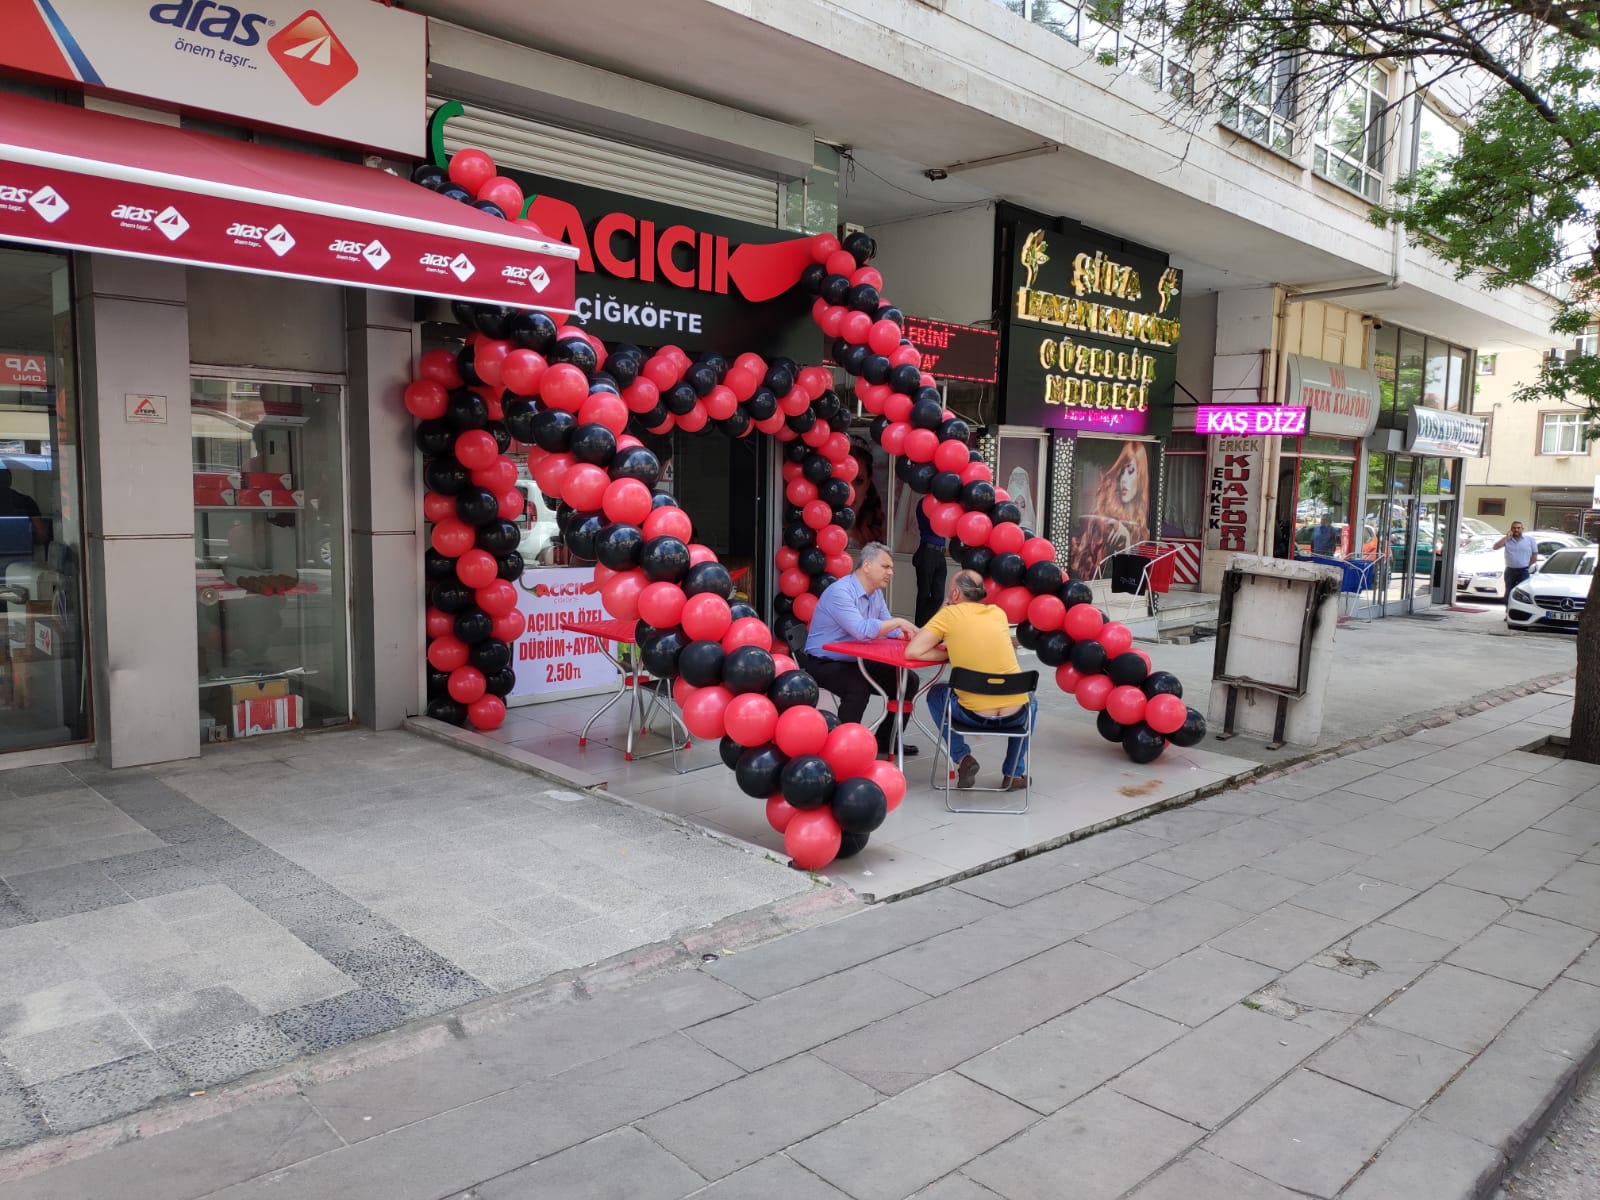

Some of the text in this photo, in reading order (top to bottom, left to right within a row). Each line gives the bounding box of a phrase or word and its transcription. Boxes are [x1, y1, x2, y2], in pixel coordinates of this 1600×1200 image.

[174, 38, 215, 58] önem
[111, 204, 153, 222] aras
[226, 222, 266, 240] aras
[328, 239, 364, 255] aras
[419, 252, 451, 267] aras
[501, 265, 530, 279] aras
[575, 294, 703, 335] ÇİĞKÖFTE
[1207, 411, 1249, 433] KAŞ
[1218, 439, 1259, 452] ERKEK
[1209, 467, 1225, 530] ERKEK
